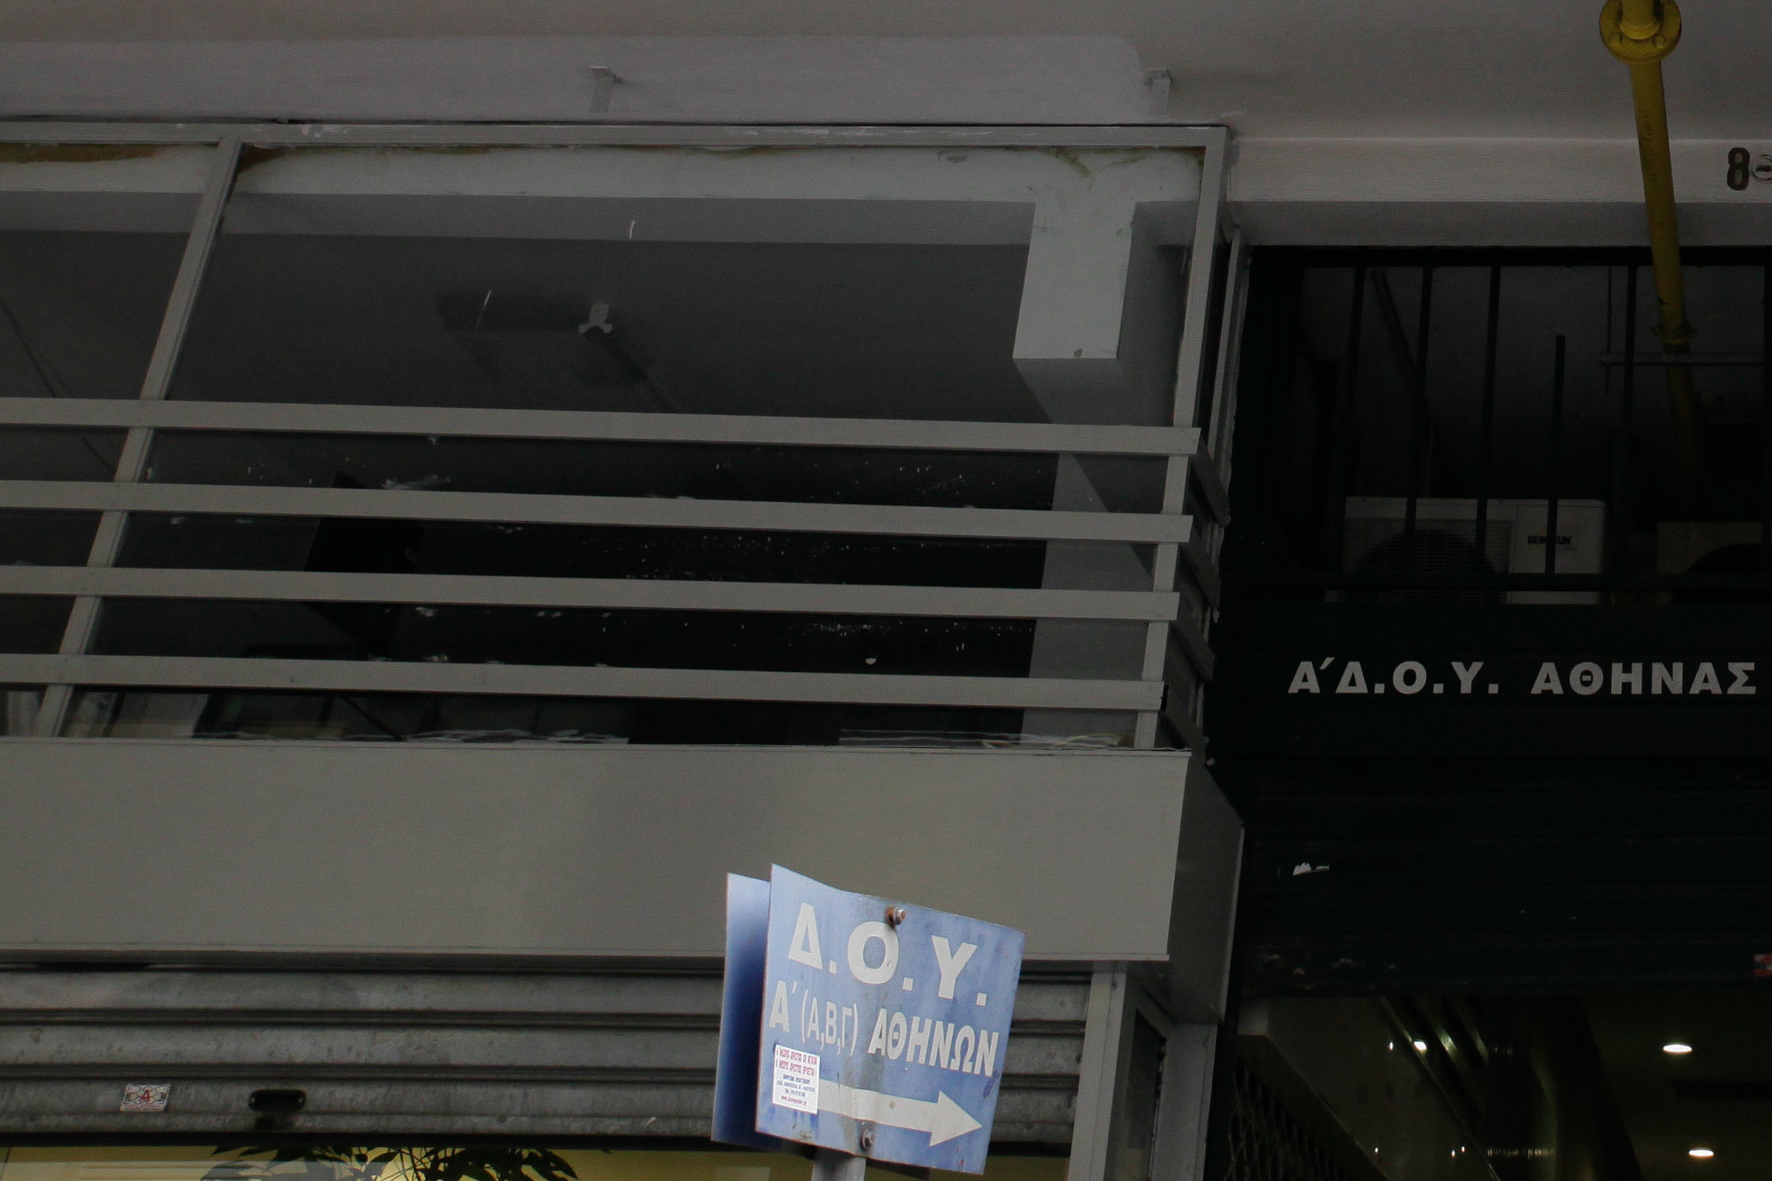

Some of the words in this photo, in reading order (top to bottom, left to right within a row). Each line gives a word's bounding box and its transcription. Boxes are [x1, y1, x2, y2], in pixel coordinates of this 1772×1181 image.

[1530, 661, 1757, 695] ΑΘΗΝΑΣ
[788, 902, 987, 1006] Δ.Ο.Υ.
[867, 1008, 1000, 1077] ΑΘΗΝΩΝ
